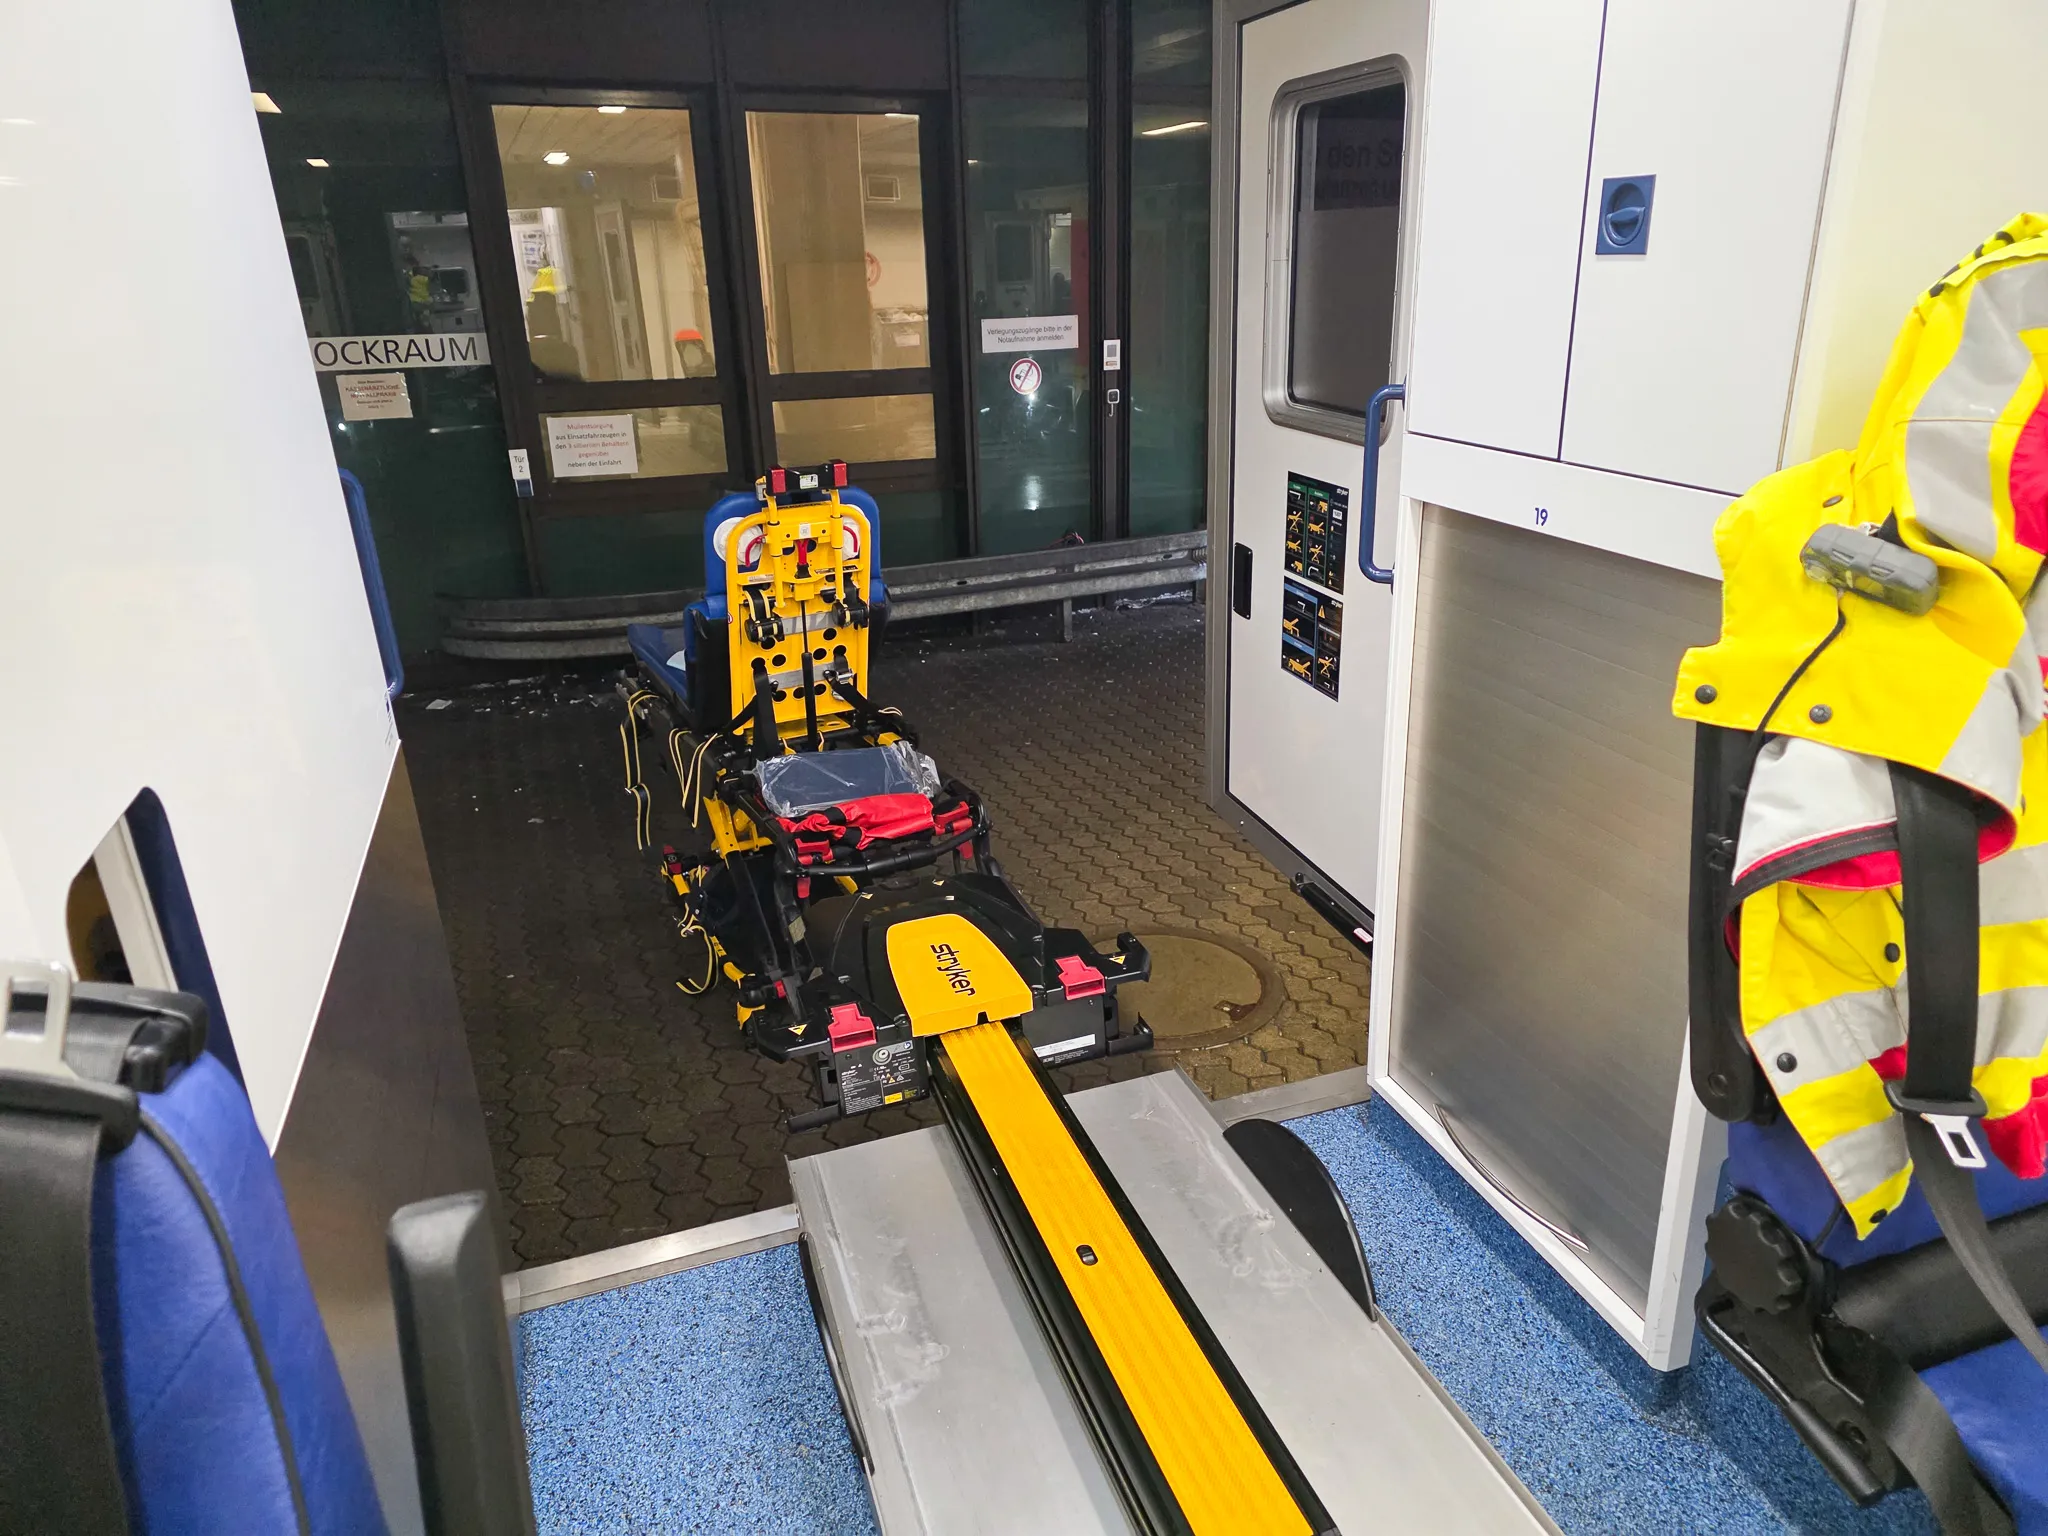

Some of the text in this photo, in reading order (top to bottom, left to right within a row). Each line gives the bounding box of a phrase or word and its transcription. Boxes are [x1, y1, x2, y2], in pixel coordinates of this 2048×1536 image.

[987, 327, 1042, 335] Verlegungszugänge
[1043, 325, 1056, 333] bitte
[1063, 324, 1073, 332] der
[997, 334, 1064, 343] Notaufnahme anmelden
[314, 336, 478, 367] OCKRAUM
[555, 433, 566, 441] aus
[567, 431, 620, 440] Einsatzfahrzeugen
[555, 442, 567, 450] den
[513, 455, 525, 463] Tür
[567, 459, 622, 468] neben der Einfahrt
[1534, 507, 1549, 527] 19
[929, 943, 976, 996] stryker
